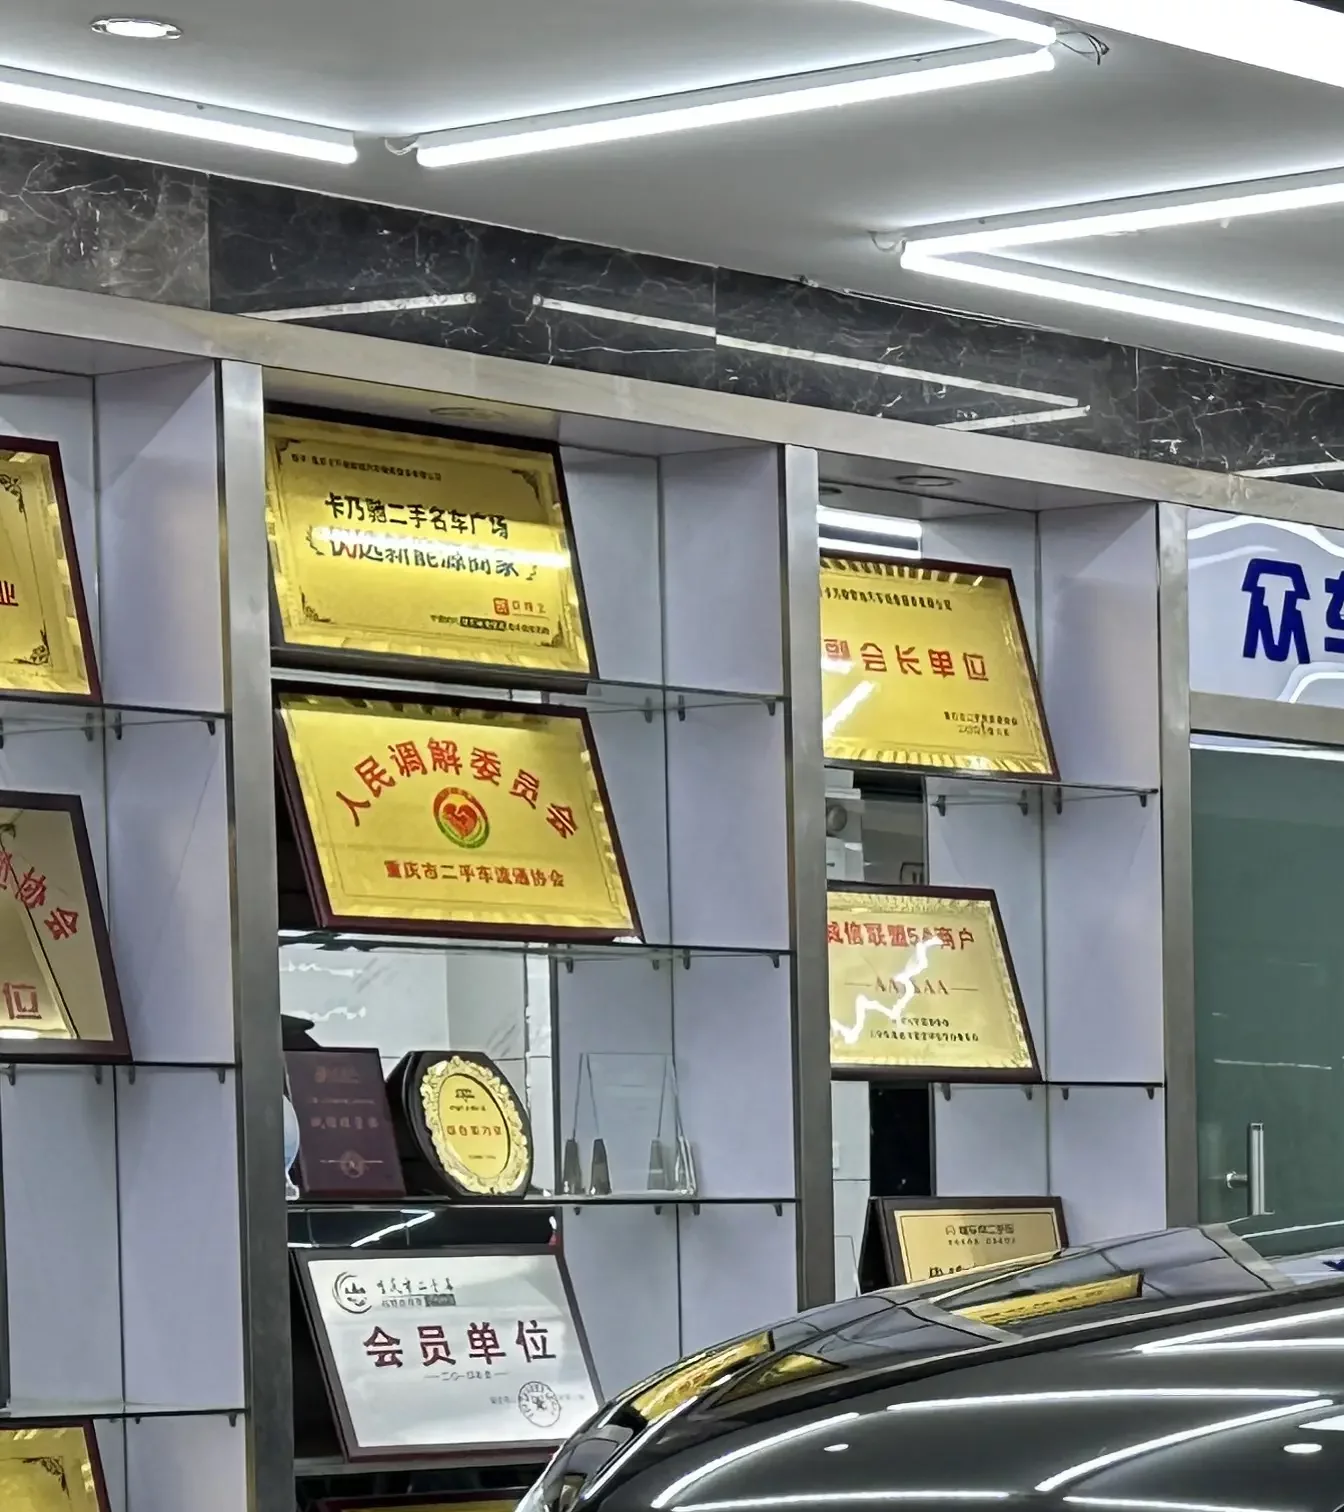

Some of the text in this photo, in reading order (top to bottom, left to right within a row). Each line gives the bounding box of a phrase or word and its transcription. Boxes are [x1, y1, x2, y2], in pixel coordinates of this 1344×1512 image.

[336, 737, 578, 839] 人民调解委员会
[363, 1319, 557, 1369] 会员单位
